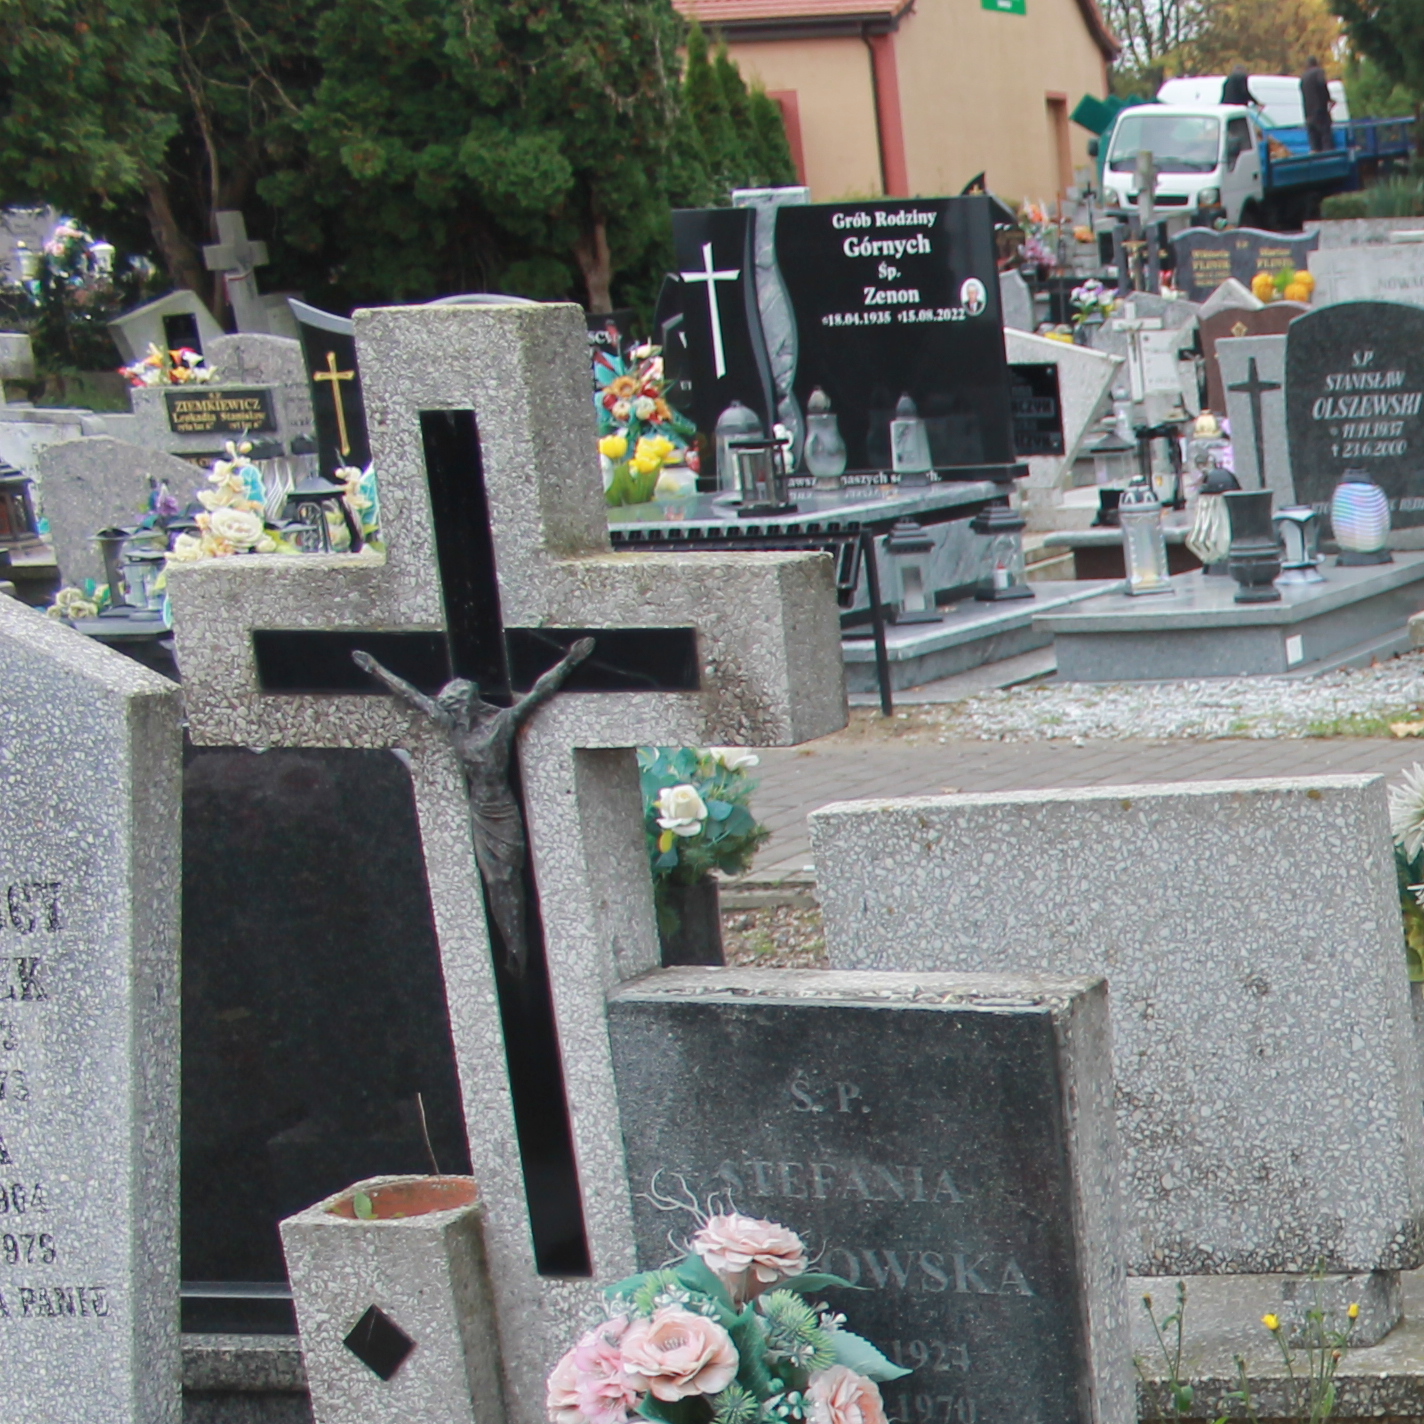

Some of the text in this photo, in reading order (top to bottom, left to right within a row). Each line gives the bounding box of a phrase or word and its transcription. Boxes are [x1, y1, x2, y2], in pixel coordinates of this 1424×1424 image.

[832, 208, 938, 230] Grób Rodziny
[843, 233, 932, 260] Górnych
[863, 286, 920, 306] Zenon
[1325, 370, 1406, 392] STANISŁAW
[174, 398, 261, 413] ZIEMKIEWICZ
[1311, 392, 1424, 421] OLSZEWSKI
[716, 1160, 965, 1204] STEFANIA
